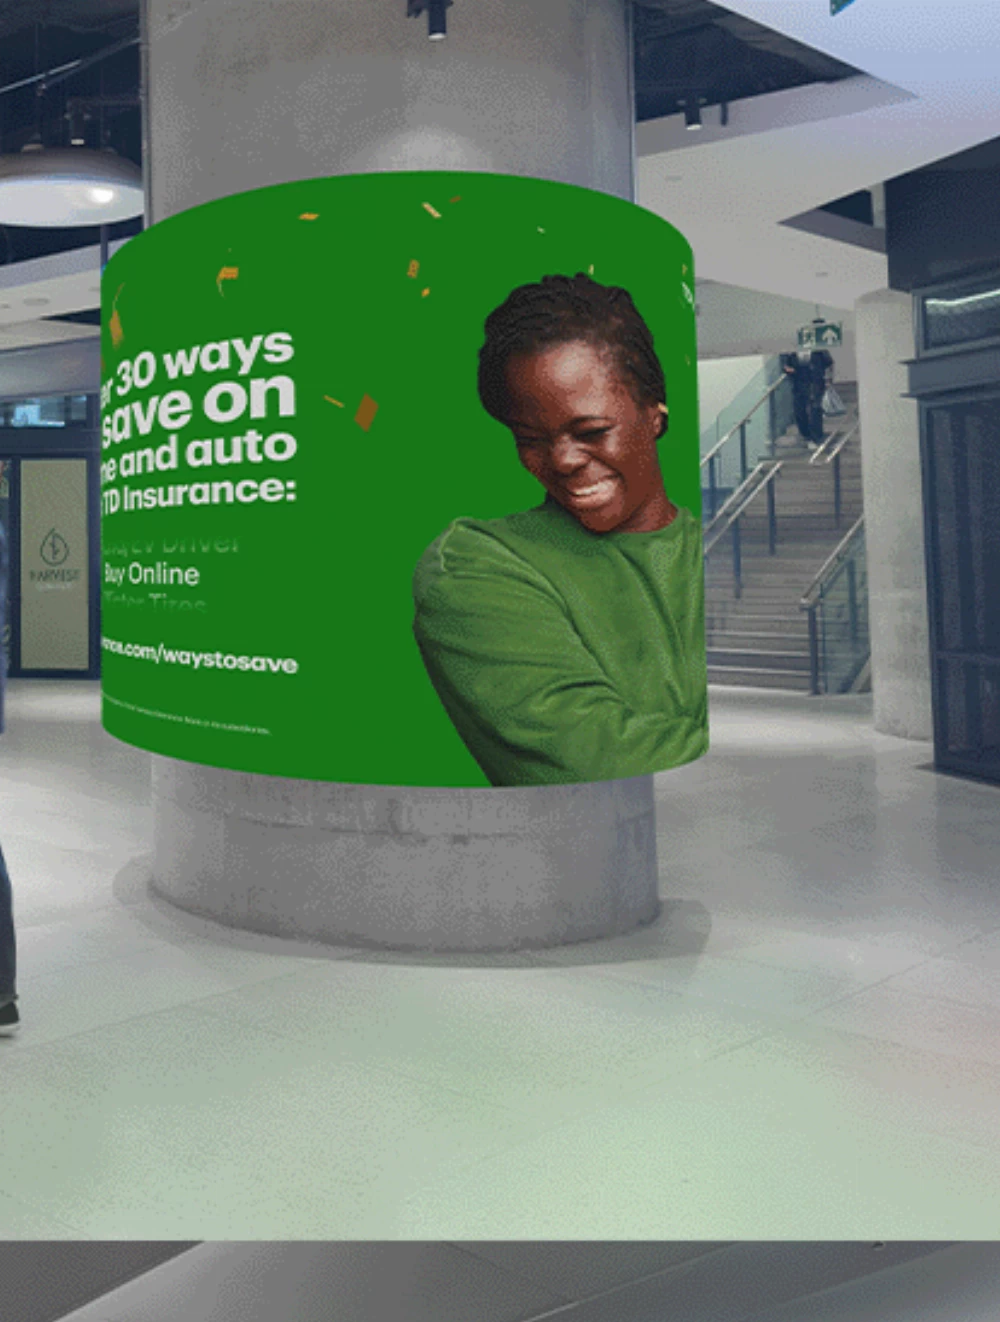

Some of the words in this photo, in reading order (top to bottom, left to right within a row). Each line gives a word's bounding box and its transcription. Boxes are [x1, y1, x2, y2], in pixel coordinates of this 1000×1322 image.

[116, 351, 157, 396] 30
[163, 331, 295, 376] ways
[102, 390, 193, 449] save
[204, 374, 296, 423] on
[119, 433, 178, 477] and
[186, 430, 297, 468] auto
[103, 488, 120, 515] TD
[123, 477, 297, 511] Insurance:
[129, 561, 200, 586] Online
